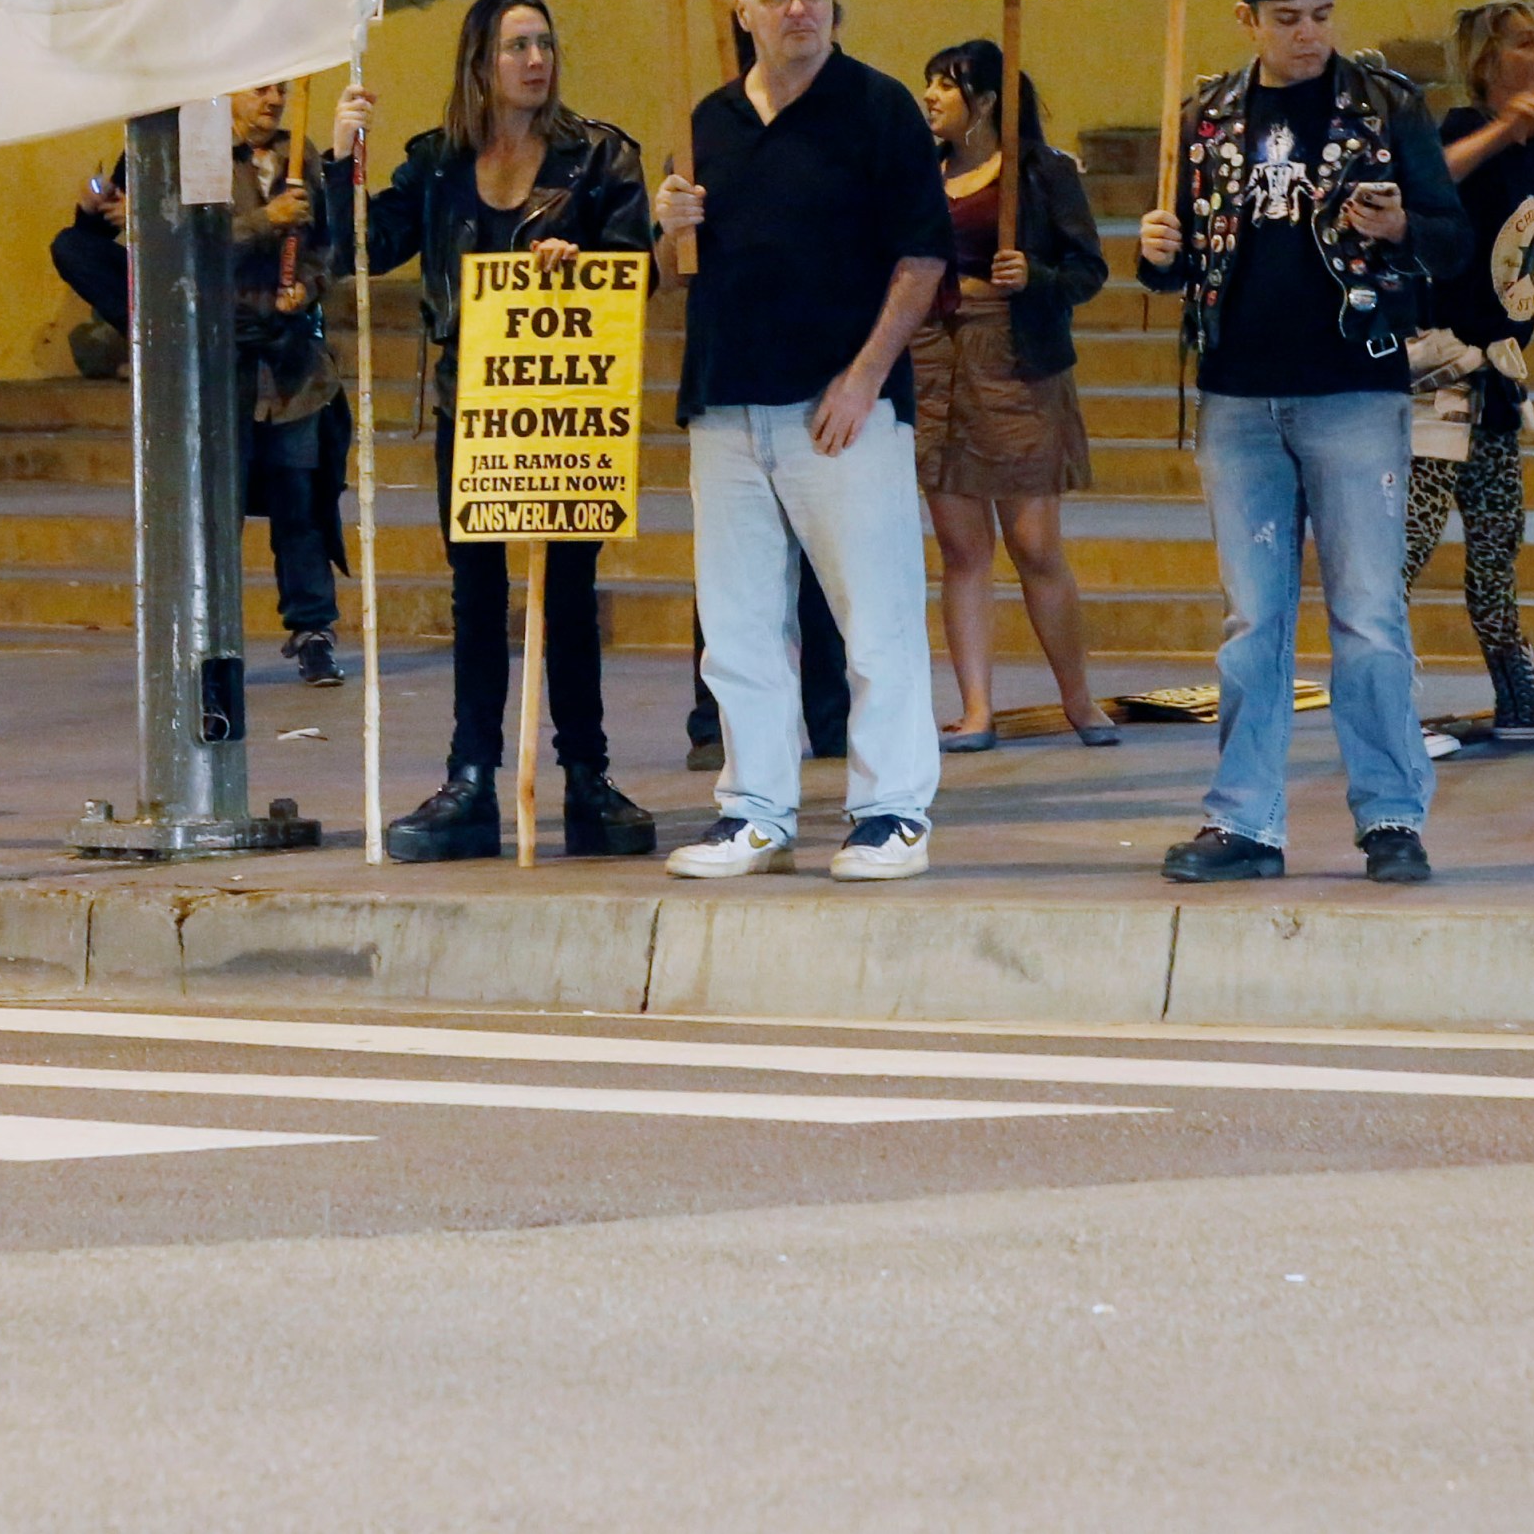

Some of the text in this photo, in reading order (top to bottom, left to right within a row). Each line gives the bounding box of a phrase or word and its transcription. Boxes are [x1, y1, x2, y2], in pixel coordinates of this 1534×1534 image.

[473, 259, 638, 301] JUSTICE
[505, 307, 592, 339] FOR
[483, 354, 616, 386] KELLY
[460, 406, 630, 438] THOMAS
[470, 454, 612, 474] JAIL RAMOS &
[459, 476, 626, 492] CICINELLI NOW!
[467, 502, 615, 532] ANSWERLA.ORG
